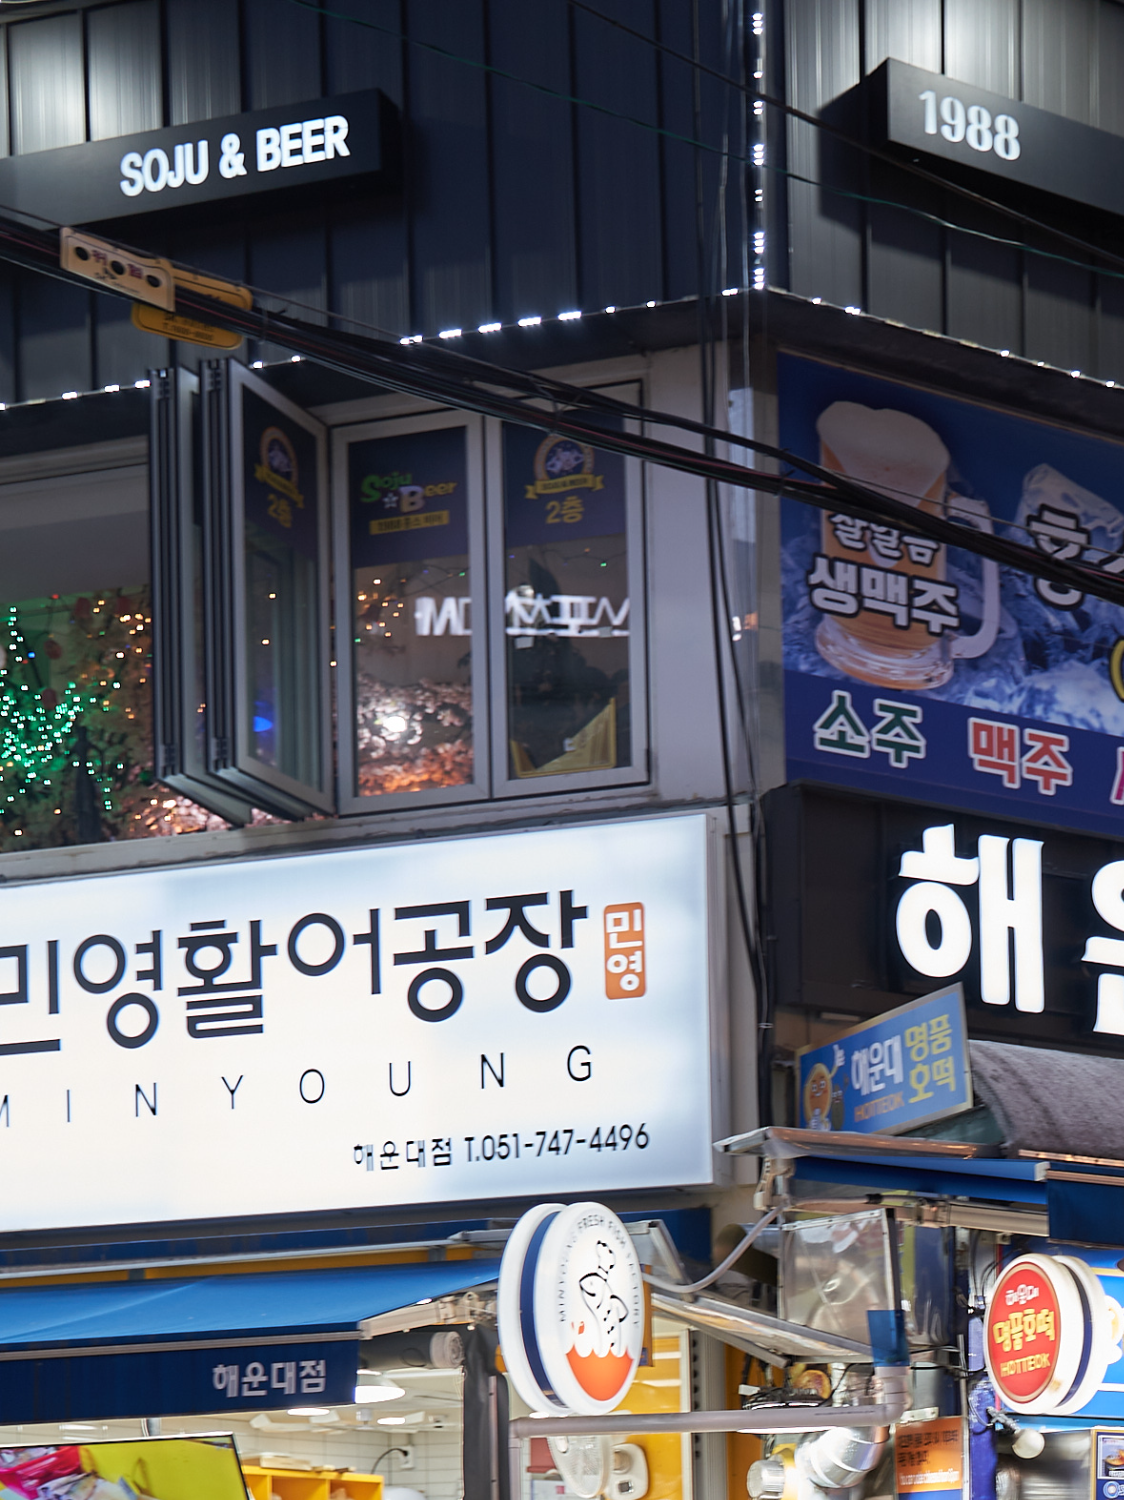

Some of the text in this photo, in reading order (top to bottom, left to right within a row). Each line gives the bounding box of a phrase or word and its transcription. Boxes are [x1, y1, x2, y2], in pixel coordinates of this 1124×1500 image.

[919, 90, 1021, 160] 1988
[120, 115, 350, 197] SOJU & BEER
[361, 471, 412, 503] Soju
[401, 482, 457, 513] Beer
[545, 495, 585, 525] 2층
[807, 554, 960, 634] 생맥주
[814, 691, 926, 768] 소주
[968, 717, 1072, 795] 맥주
[0, 889, 588, 1056] 민영활어공장
[604, 906, 646, 994] 민영
[904, 1013, 953, 1062] 명품
[850, 1034, 904, 1096] 해운대
[907, 1056, 957, 1104] 호떡
[353, 1122, 651, 1173] 해운대점 T.051-747-4496
[992, 1308, 1056, 1352] 명품호떡
[212, 1359, 328, 1398] 해운대점
[1000, 1353, 1051, 1378] HOTTEOK
